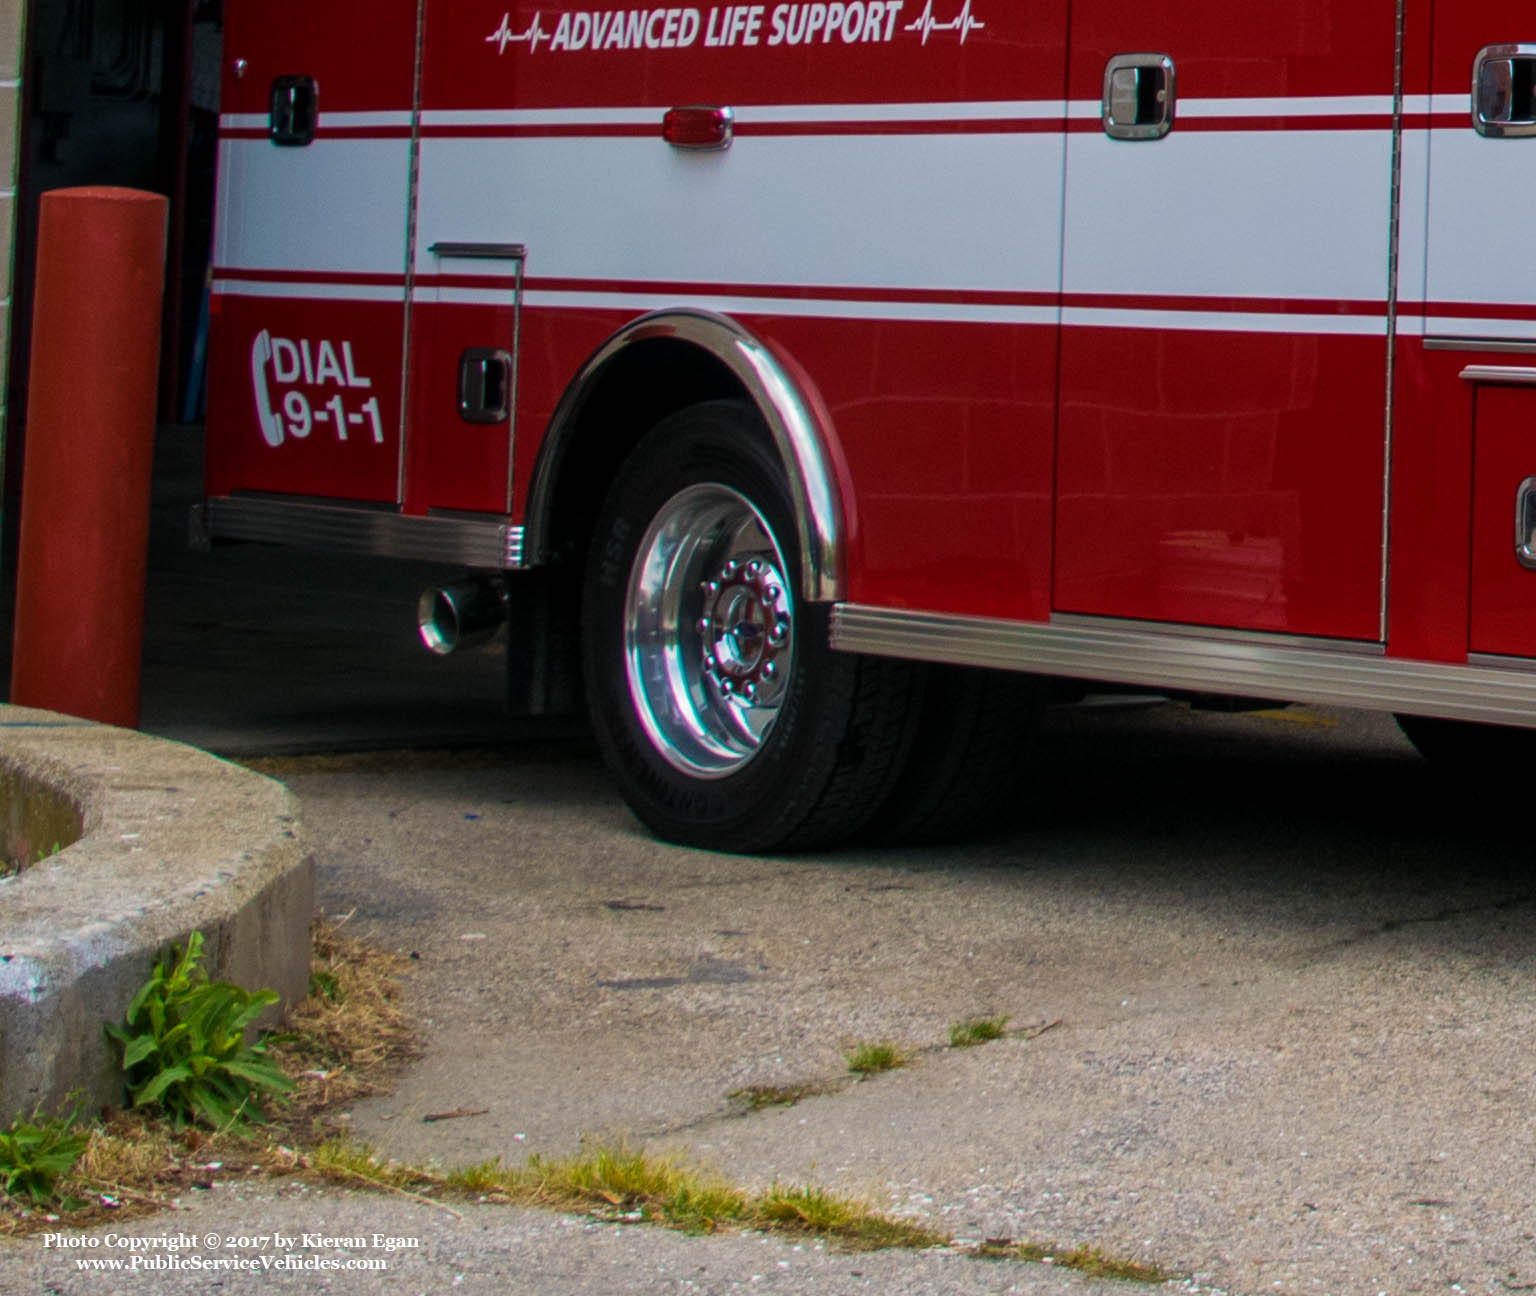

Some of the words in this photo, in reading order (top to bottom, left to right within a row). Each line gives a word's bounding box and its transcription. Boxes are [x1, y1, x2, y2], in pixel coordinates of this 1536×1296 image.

[549, 4, 698, 52] ADVANCED
[704, 2, 762, 48] LIFE
[767, 0, 904, 45] SUPPORT
[272, 337, 371, 388] DIAL
[283, 389, 384, 444] 9-1-1
